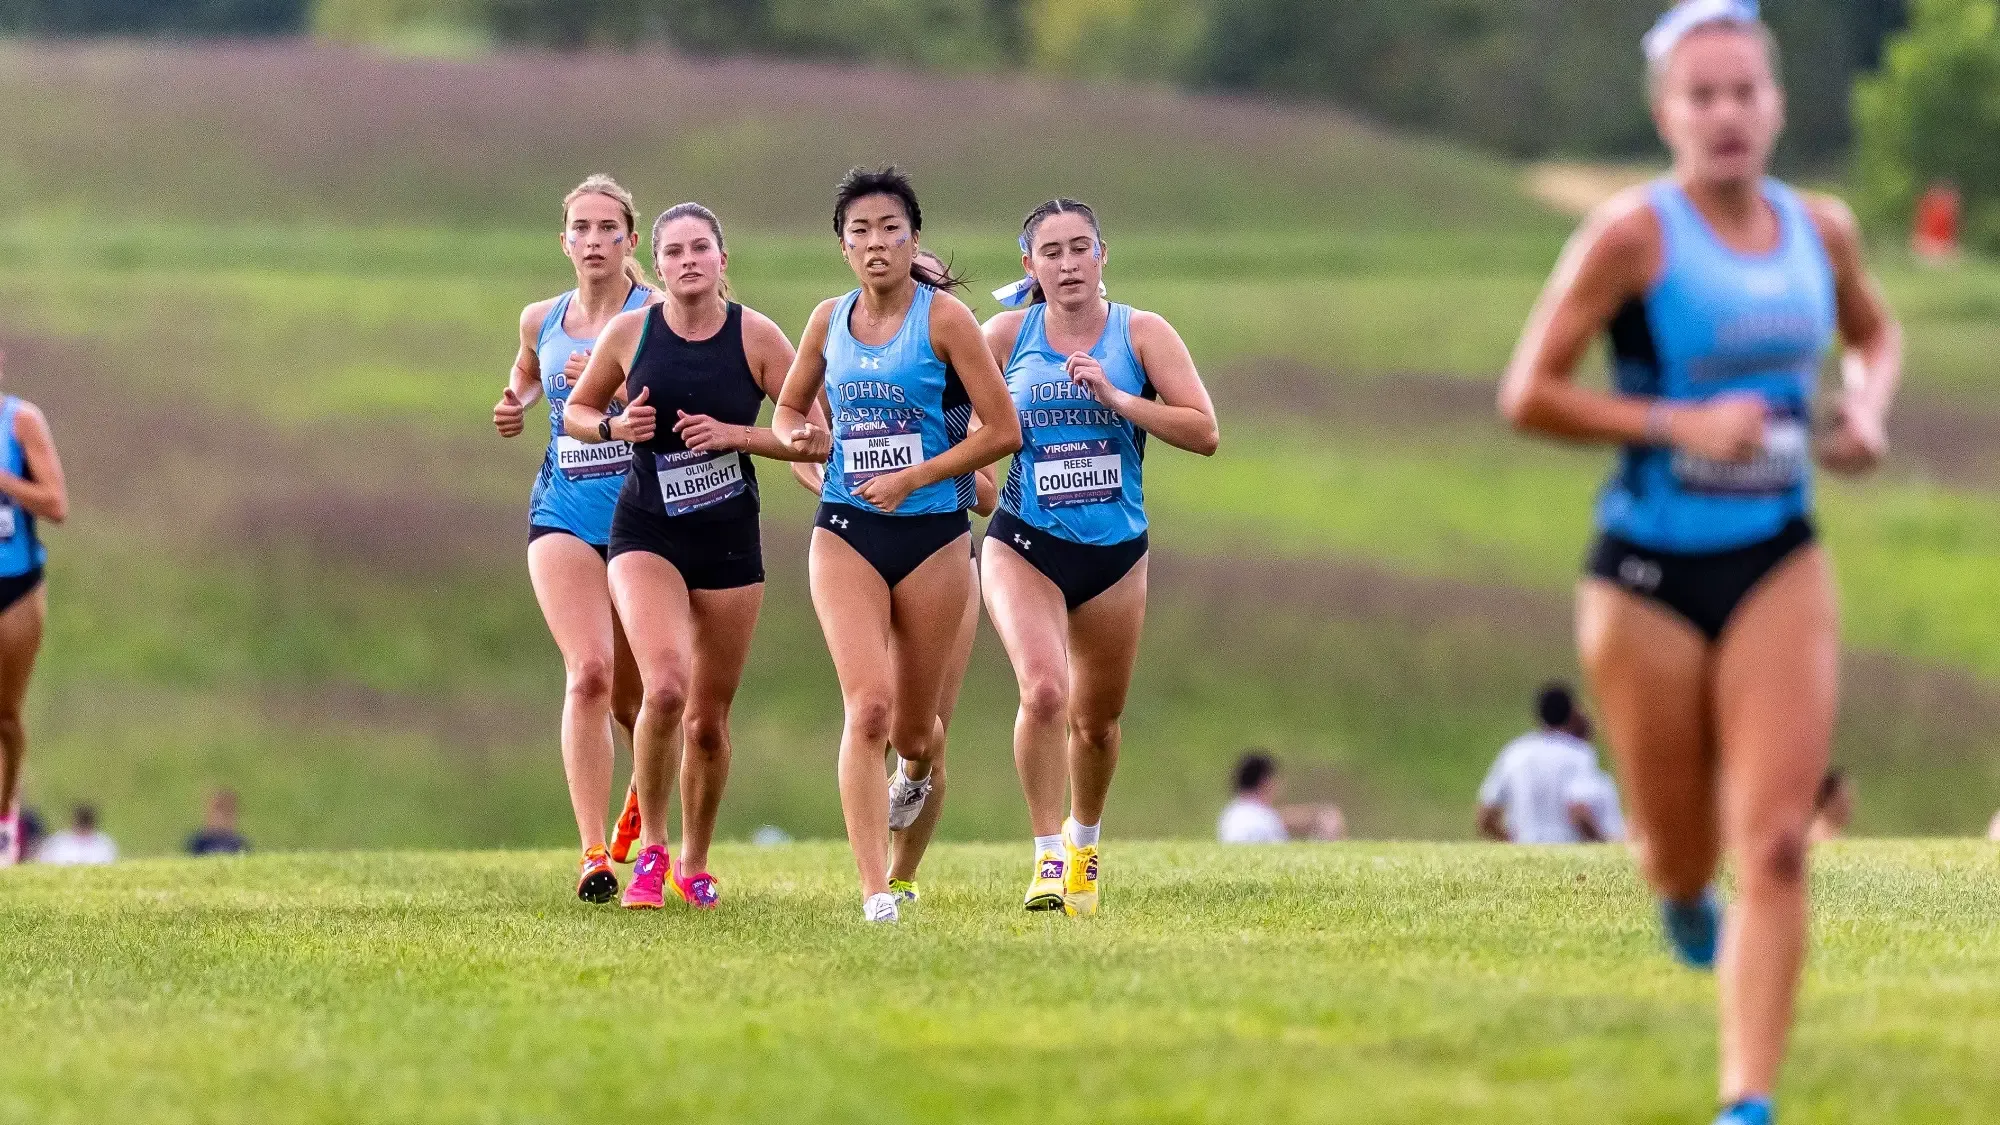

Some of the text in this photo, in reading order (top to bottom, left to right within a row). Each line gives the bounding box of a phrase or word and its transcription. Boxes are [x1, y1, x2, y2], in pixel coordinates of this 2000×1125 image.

[838, 381, 906, 403] JOHNS
[1031, 380, 1100, 404] JOHN
[851, 421, 887, 431] VIRGINIA
[1020, 409, 1121, 429] HOPKINS
[561, 443, 633, 463] FERNANDEZ
[869, 438, 890, 448] ANNE
[1043, 442, 1089, 454] VIRGINIA
[853, 446, 912, 470] HIRAKI
[1064, 459, 1092, 469] REESE
[686, 462, 714, 476] OLIVIA
[666, 464, 736, 499] ALBRIGHT
[1040, 469, 1118, 491] COUGHLIN
